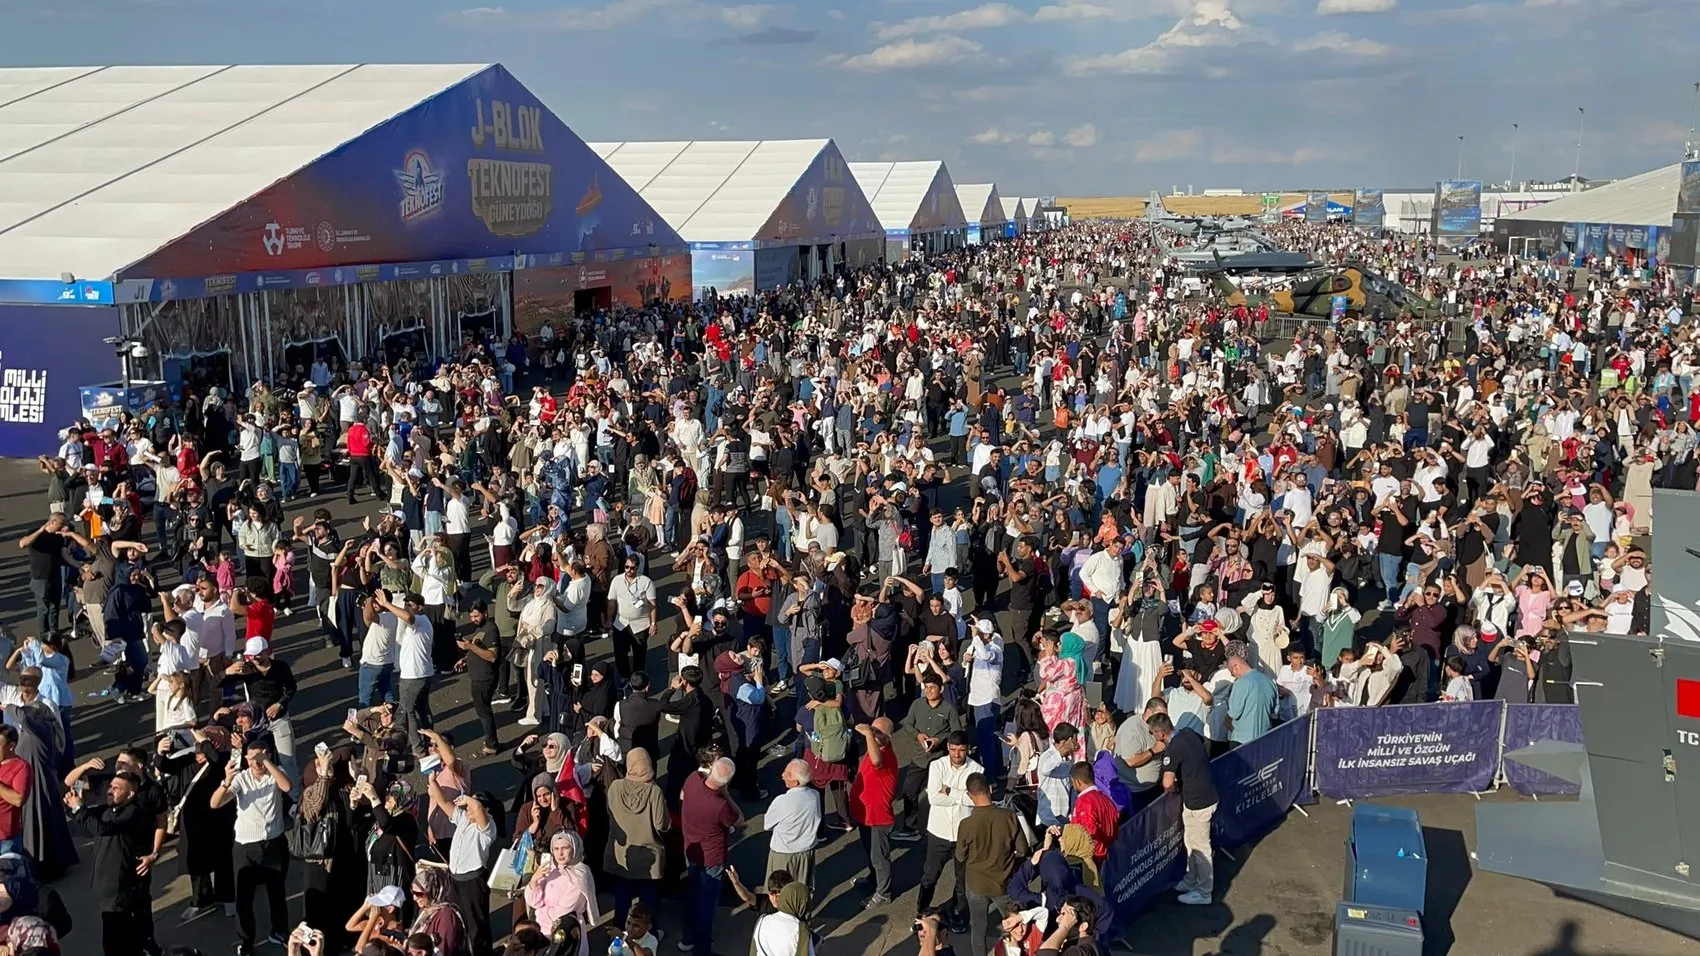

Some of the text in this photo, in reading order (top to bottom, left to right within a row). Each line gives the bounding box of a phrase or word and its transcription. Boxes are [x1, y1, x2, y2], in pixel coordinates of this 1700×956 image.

[471, 98, 544, 151] J-BLOK
[468, 160, 552, 198] TEKNOFEST
[400, 182, 444, 217] TEKNOFEST
[489, 199, 543, 222] GÜNEYDOĞU
[1367, 743, 1451, 757] MİLLİ VE ÖZGÜN
[1377, 731, 1443, 745] TÜRKİYE'NİN
[1676, 729, 1699, 746] TC
[1338, 751, 1476, 769] İLK İNSANSIZ SAVAŞ UÇAĞI
[1112, 855, 1154, 894] INDIGENOUS
[1153, 845, 1168, 863] AND
[1117, 847, 1179, 904] UNMANNED FIGHTER
